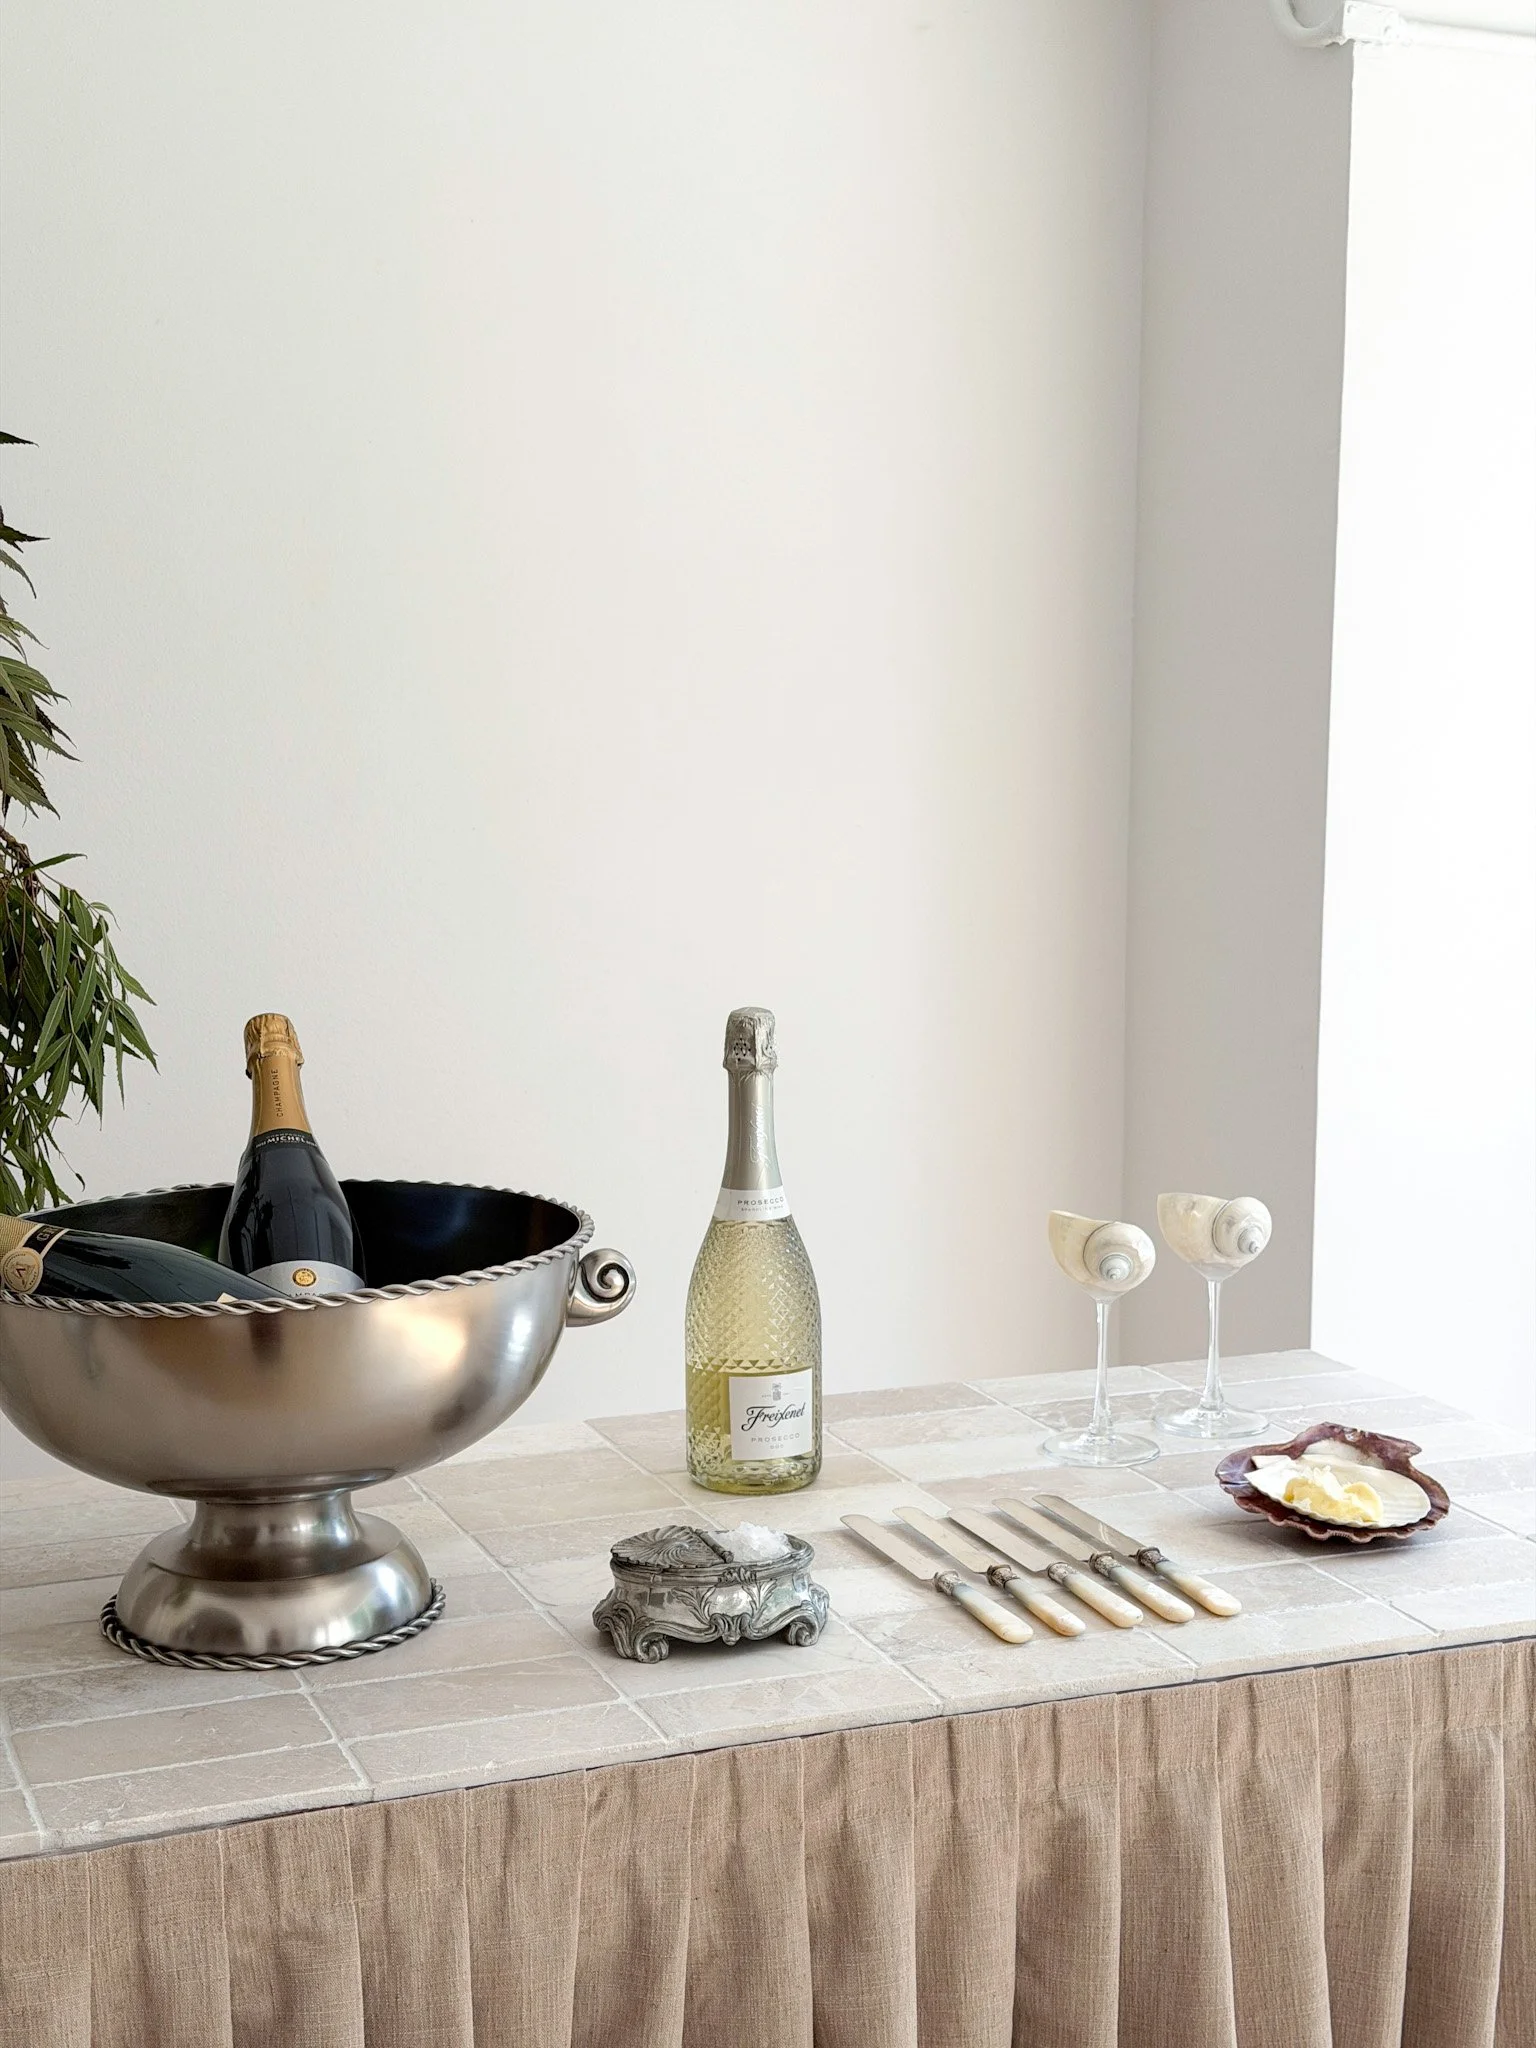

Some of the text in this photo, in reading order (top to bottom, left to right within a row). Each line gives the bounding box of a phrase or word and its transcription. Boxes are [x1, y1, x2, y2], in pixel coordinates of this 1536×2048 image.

[271, 1069, 283, 1117] CHAMPAGNE
[267, 1135, 306, 1143] MICHEL
[737, 1196, 784, 1206] PROSECCO
[741, 1401, 806, 1432] Freixenet
[751, 1432, 800, 1443] PROSECCO
